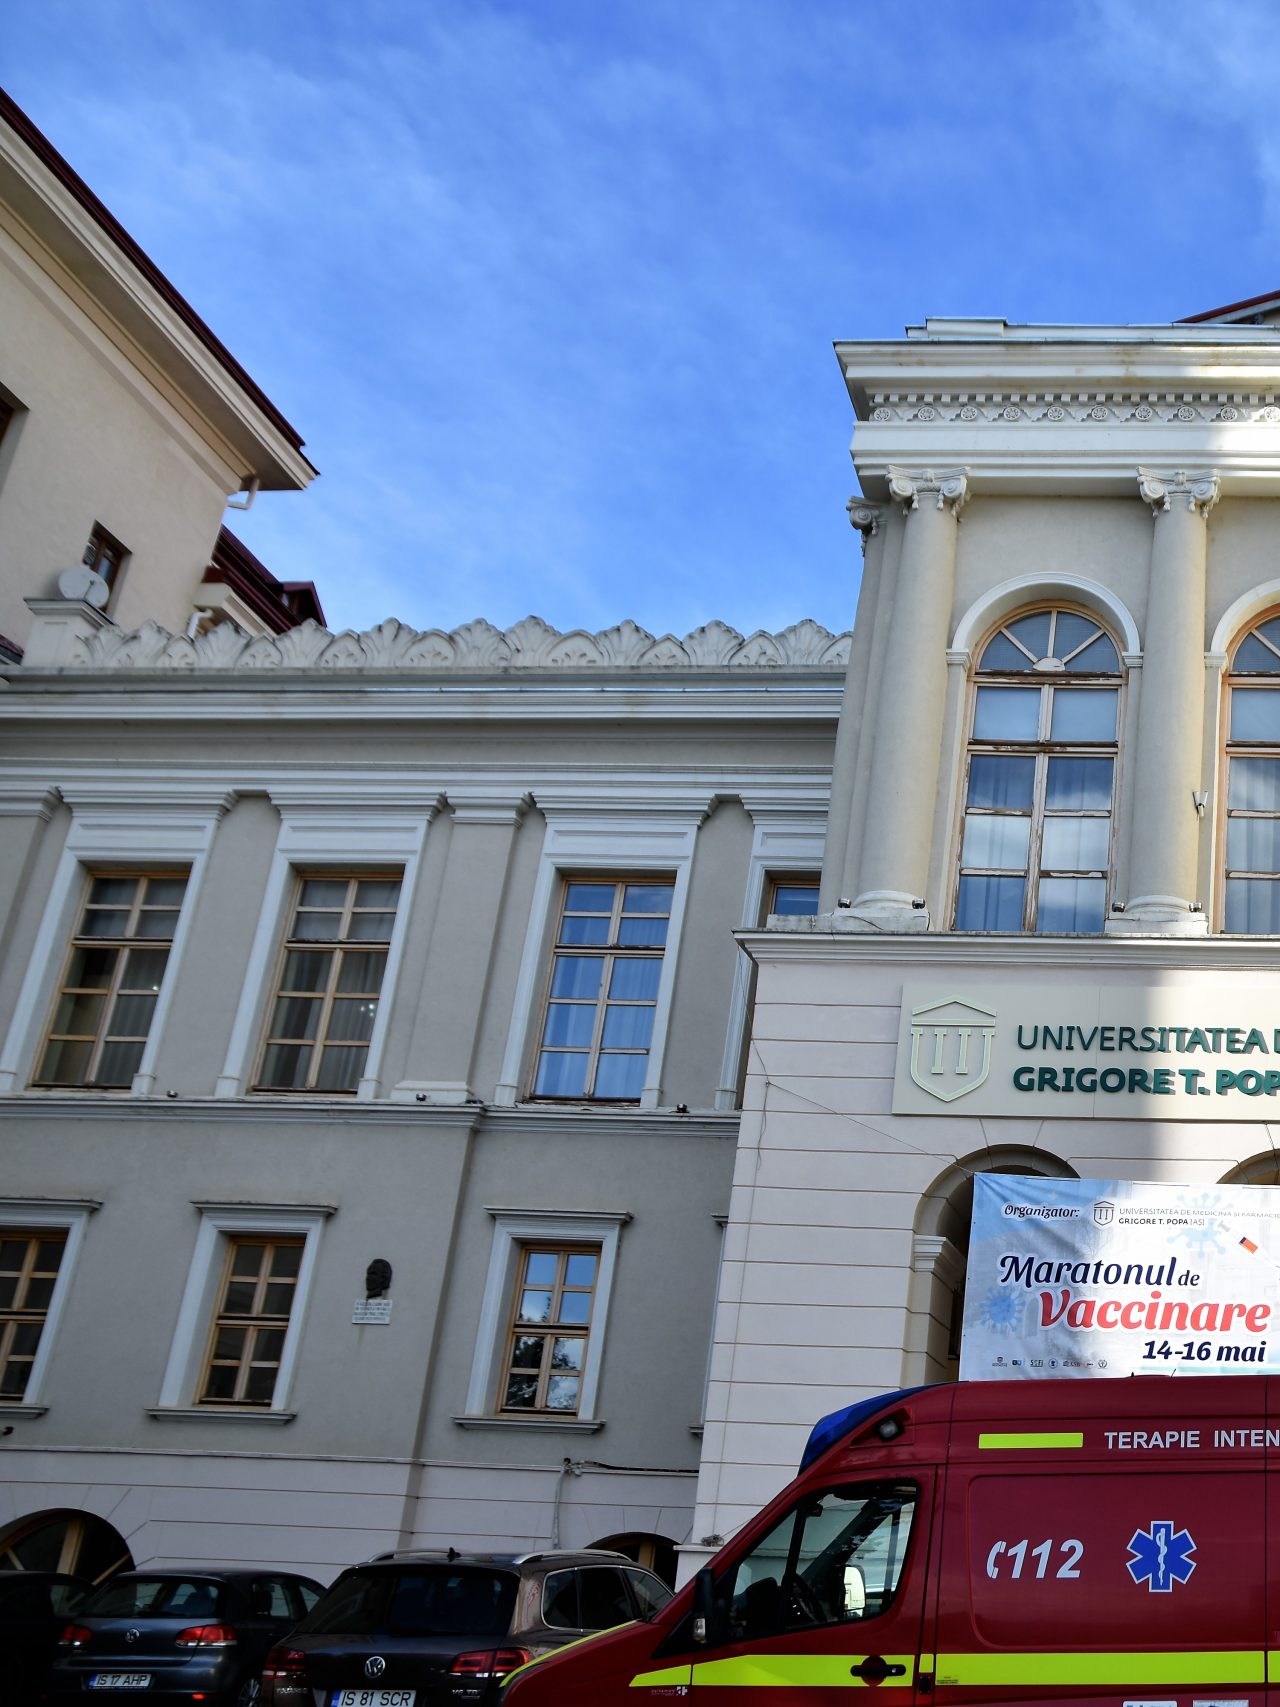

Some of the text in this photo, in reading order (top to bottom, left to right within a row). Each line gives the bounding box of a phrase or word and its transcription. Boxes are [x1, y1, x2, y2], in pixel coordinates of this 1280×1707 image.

[1017, 1024, 1266, 1053] UNIVERSITATEA
[1013, 1066, 1174, 1094] GRIGORE
[1179, 1068, 1209, 1095] T.
[1004, 1203, 1080, 1220] Organizator:
[1118, 1217, 1157, 1225] GRIGORE
[1166, 1218, 1189, 1226] POPA
[1119, 1207, 1179, 1216] UNIVERSITATEA
[999, 1255, 1200, 1289] Maratonul de
[1039, 1288, 1271, 1333] Vaccinare
[1142, 1340, 1267, 1363] 14-16 mai
[1104, 1430, 1200, 1449] TERAPIE
[1007, 1539, 1084, 1579] 112
[340, 1691, 412, 1707] IS 81 SCR
